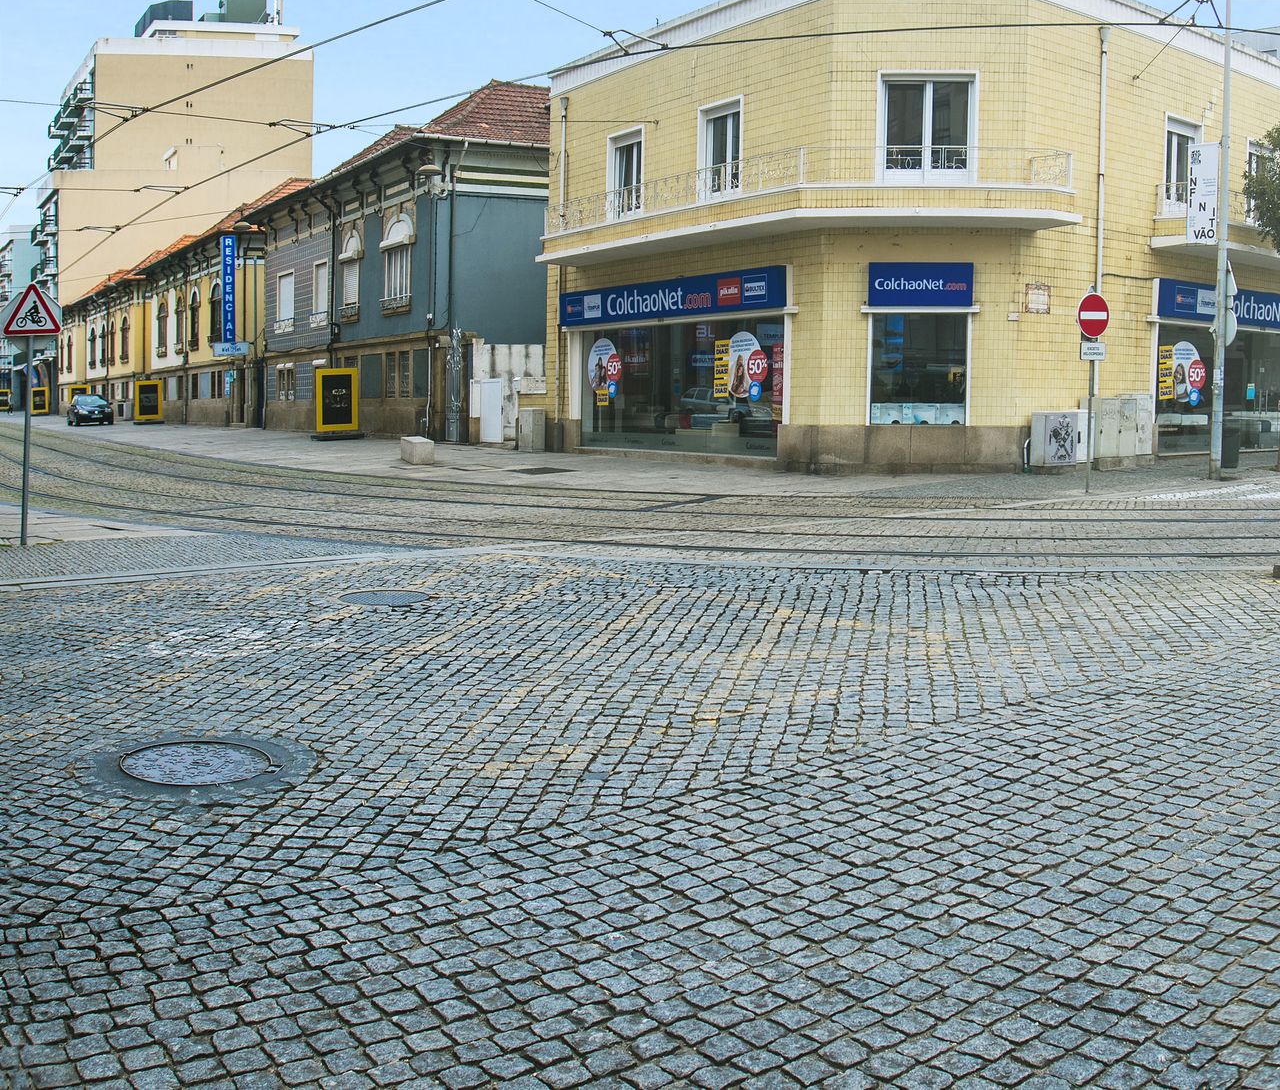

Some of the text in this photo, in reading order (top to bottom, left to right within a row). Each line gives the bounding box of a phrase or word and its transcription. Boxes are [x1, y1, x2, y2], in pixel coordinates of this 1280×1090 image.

[225, 237, 234, 340] RESIDENCIAL
[748, 358, 767, 374] 50%
[1189, 368, 1206, 381] 50%
